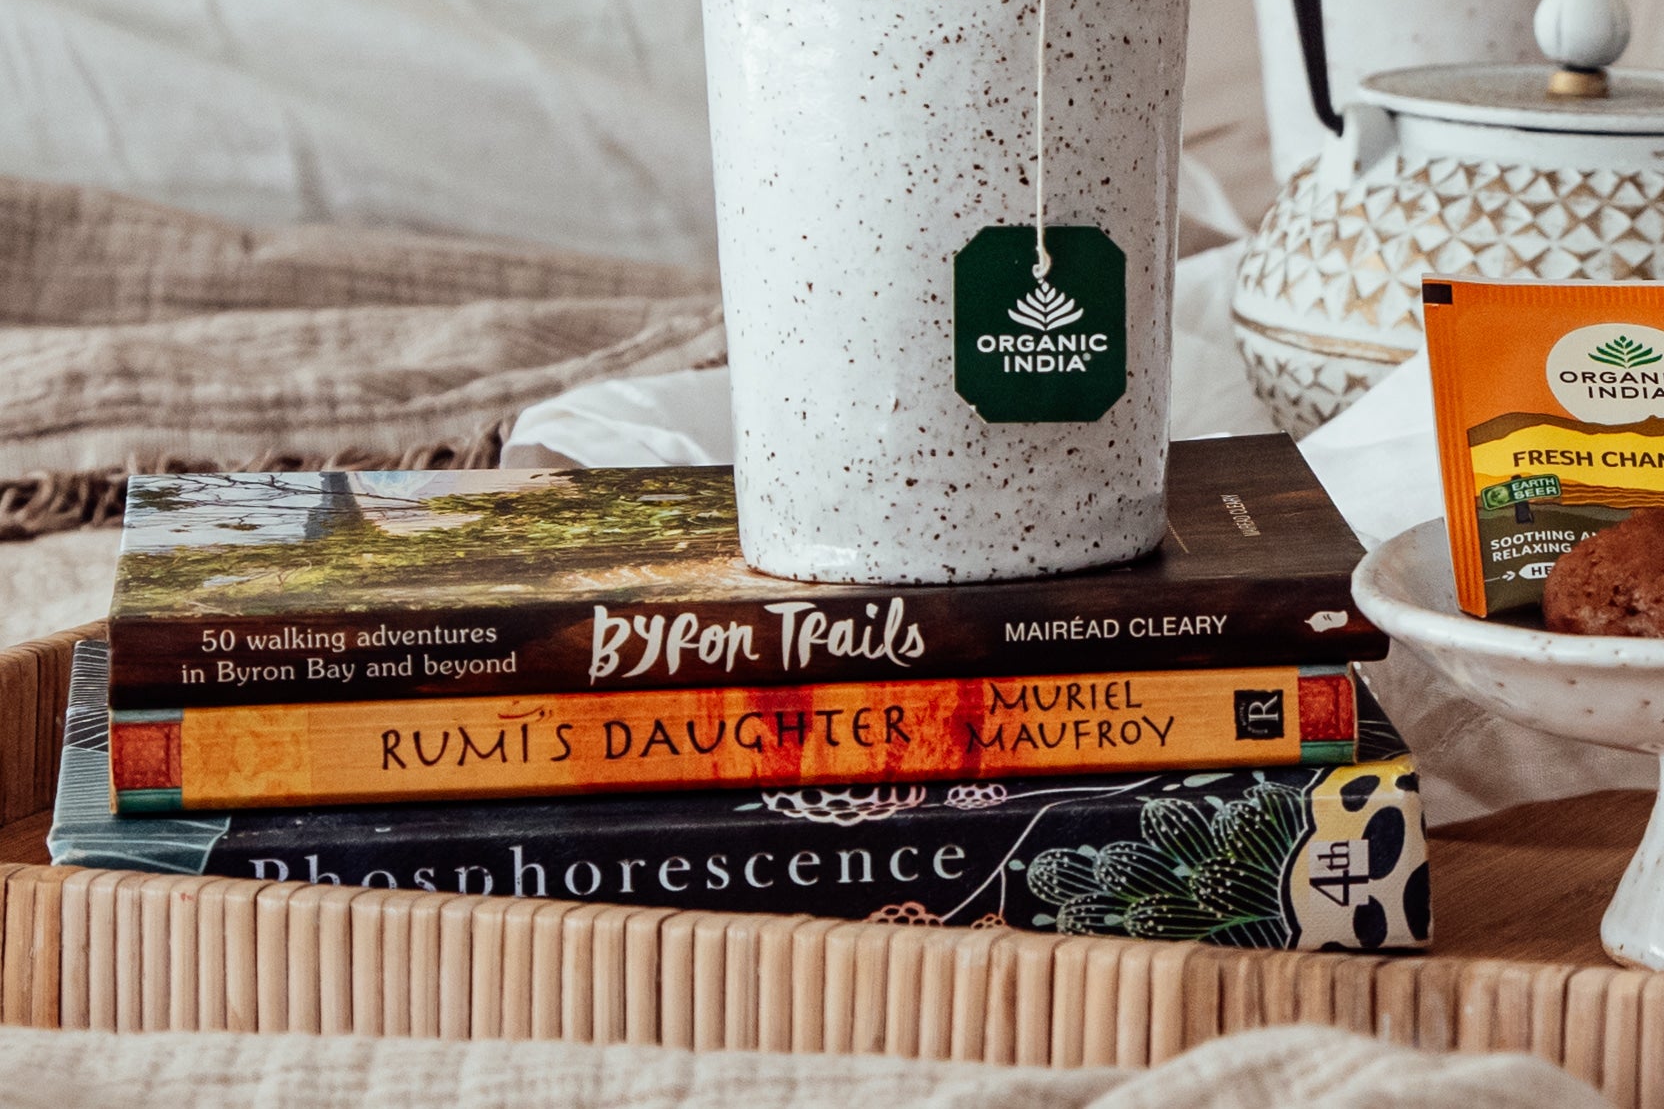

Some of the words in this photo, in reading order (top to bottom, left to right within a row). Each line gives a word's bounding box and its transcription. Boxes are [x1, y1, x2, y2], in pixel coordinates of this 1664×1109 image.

[976, 333, 1108, 353] ORGANIC
[1512, 449, 1593, 468] FRESH
[1511, 477, 1555, 491] EARTH
[1490, 530, 1575, 550] SOOTHING
[1492, 542, 1572, 562] RELAXING
[201, 629, 235, 652] 50
[247, 627, 346, 653] walking
[357, 624, 497, 649] adventures
[588, 604, 760, 686] Byron
[763, 597, 925, 671] Trails
[1005, 615, 1119, 642] MAIRÉAD
[1129, 614, 1227, 638] CLEARY
[182, 664, 205, 684] in
[217, 660, 295, 687] Byron
[307, 657, 355, 683] Bay
[366, 655, 412, 677] and
[424, 651, 517, 679] beyond
[989, 680, 1143, 715] MURIEL
[603, 705, 911, 760] DAUGHTER
[966, 715, 1174, 754] MAUFROY
[1309, 839, 1369, 907] 4th
